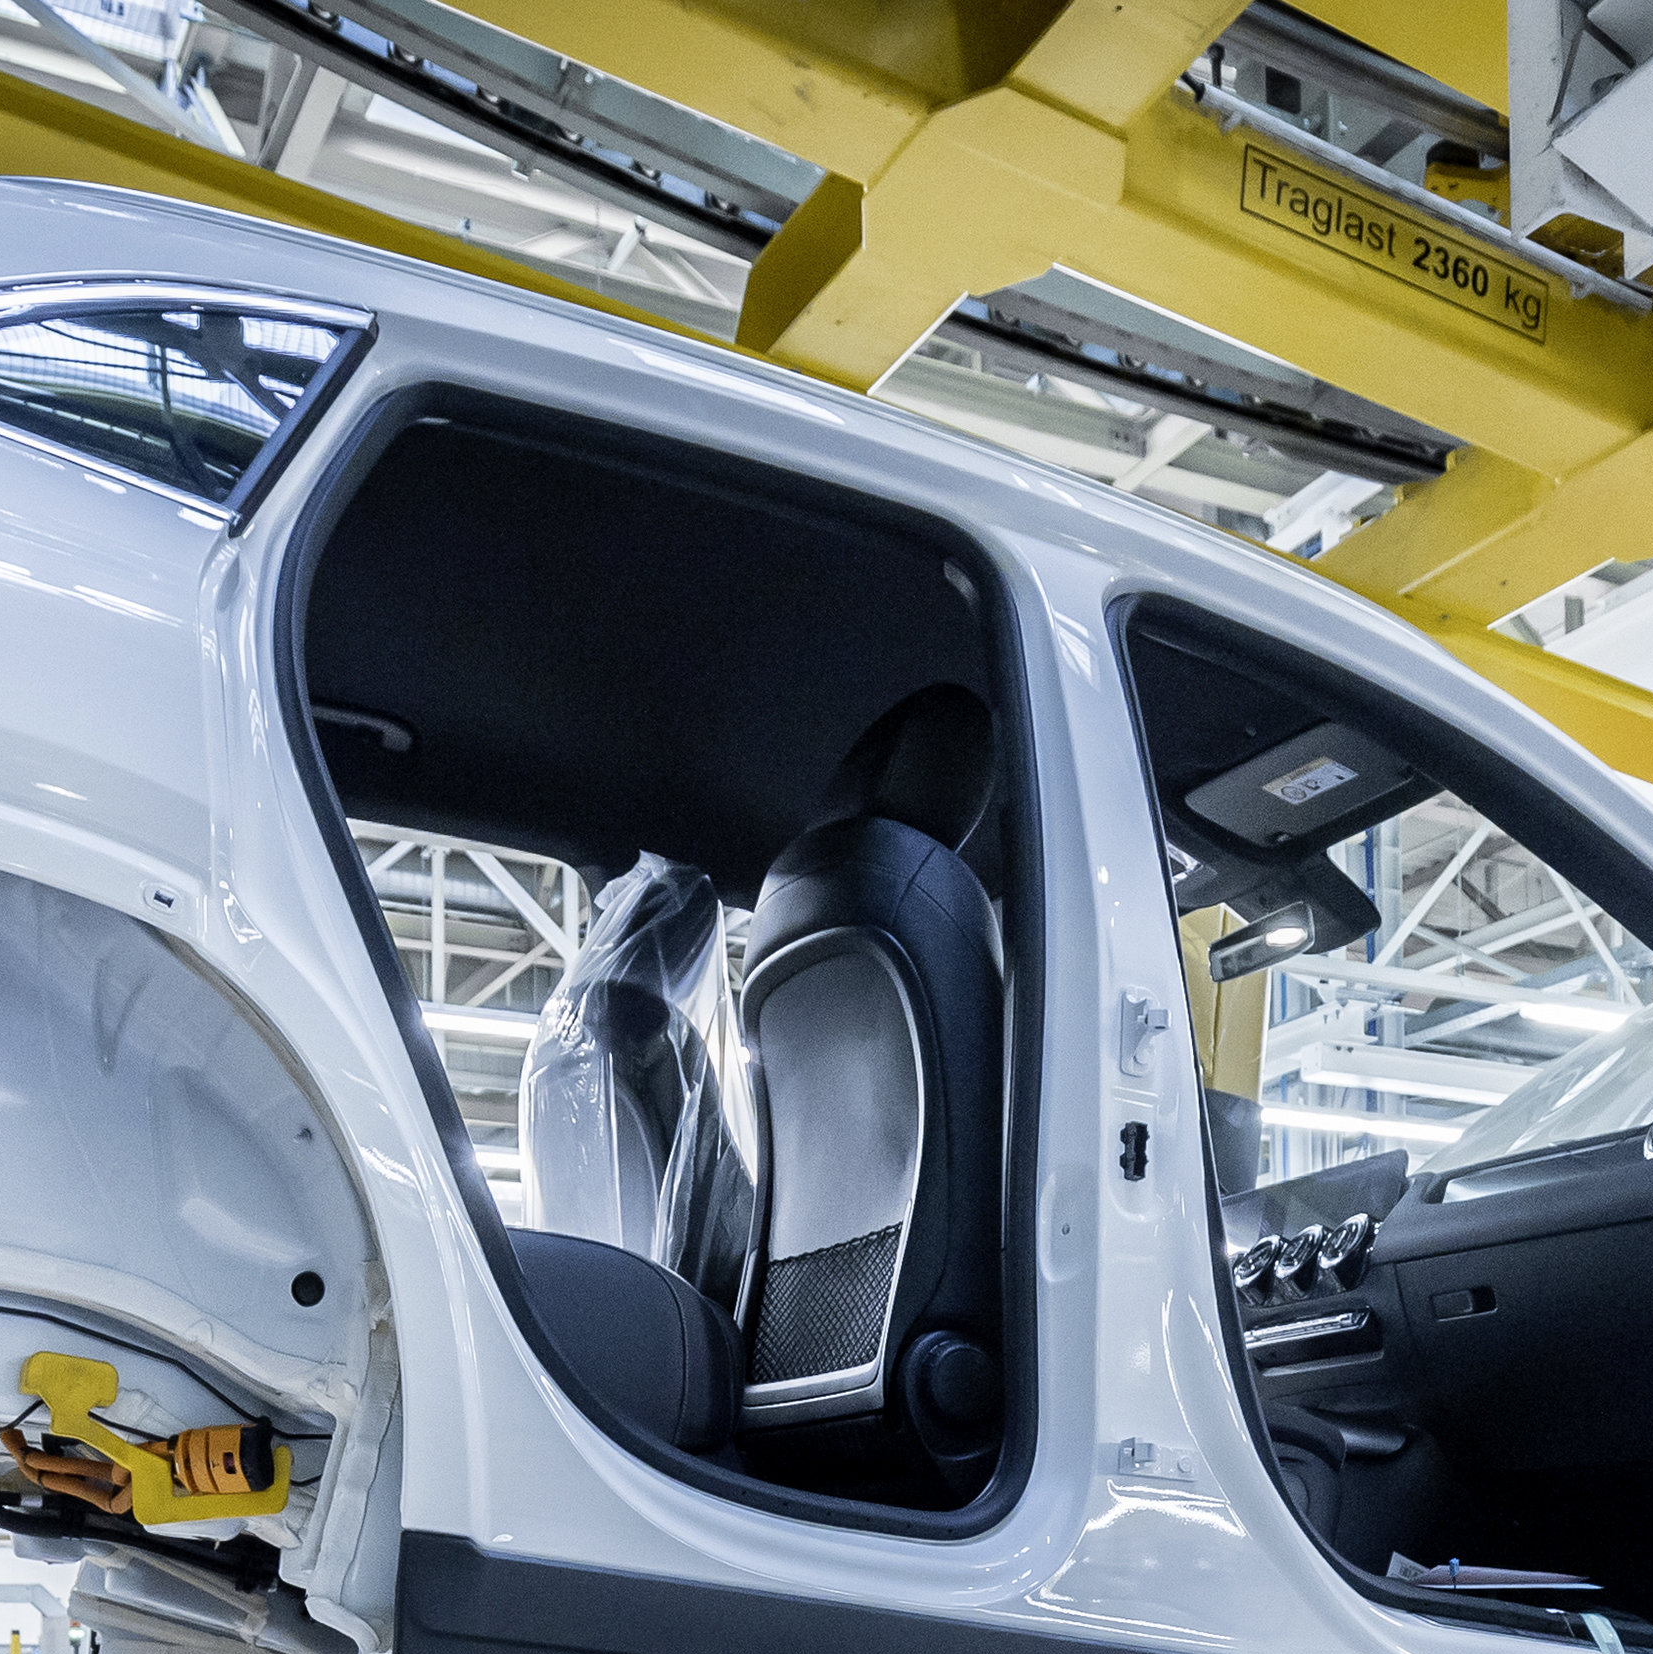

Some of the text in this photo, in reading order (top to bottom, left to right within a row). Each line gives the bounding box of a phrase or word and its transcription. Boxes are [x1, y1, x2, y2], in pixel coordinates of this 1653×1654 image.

[1252, 156, 1542, 330] Traglast 2360 kg
